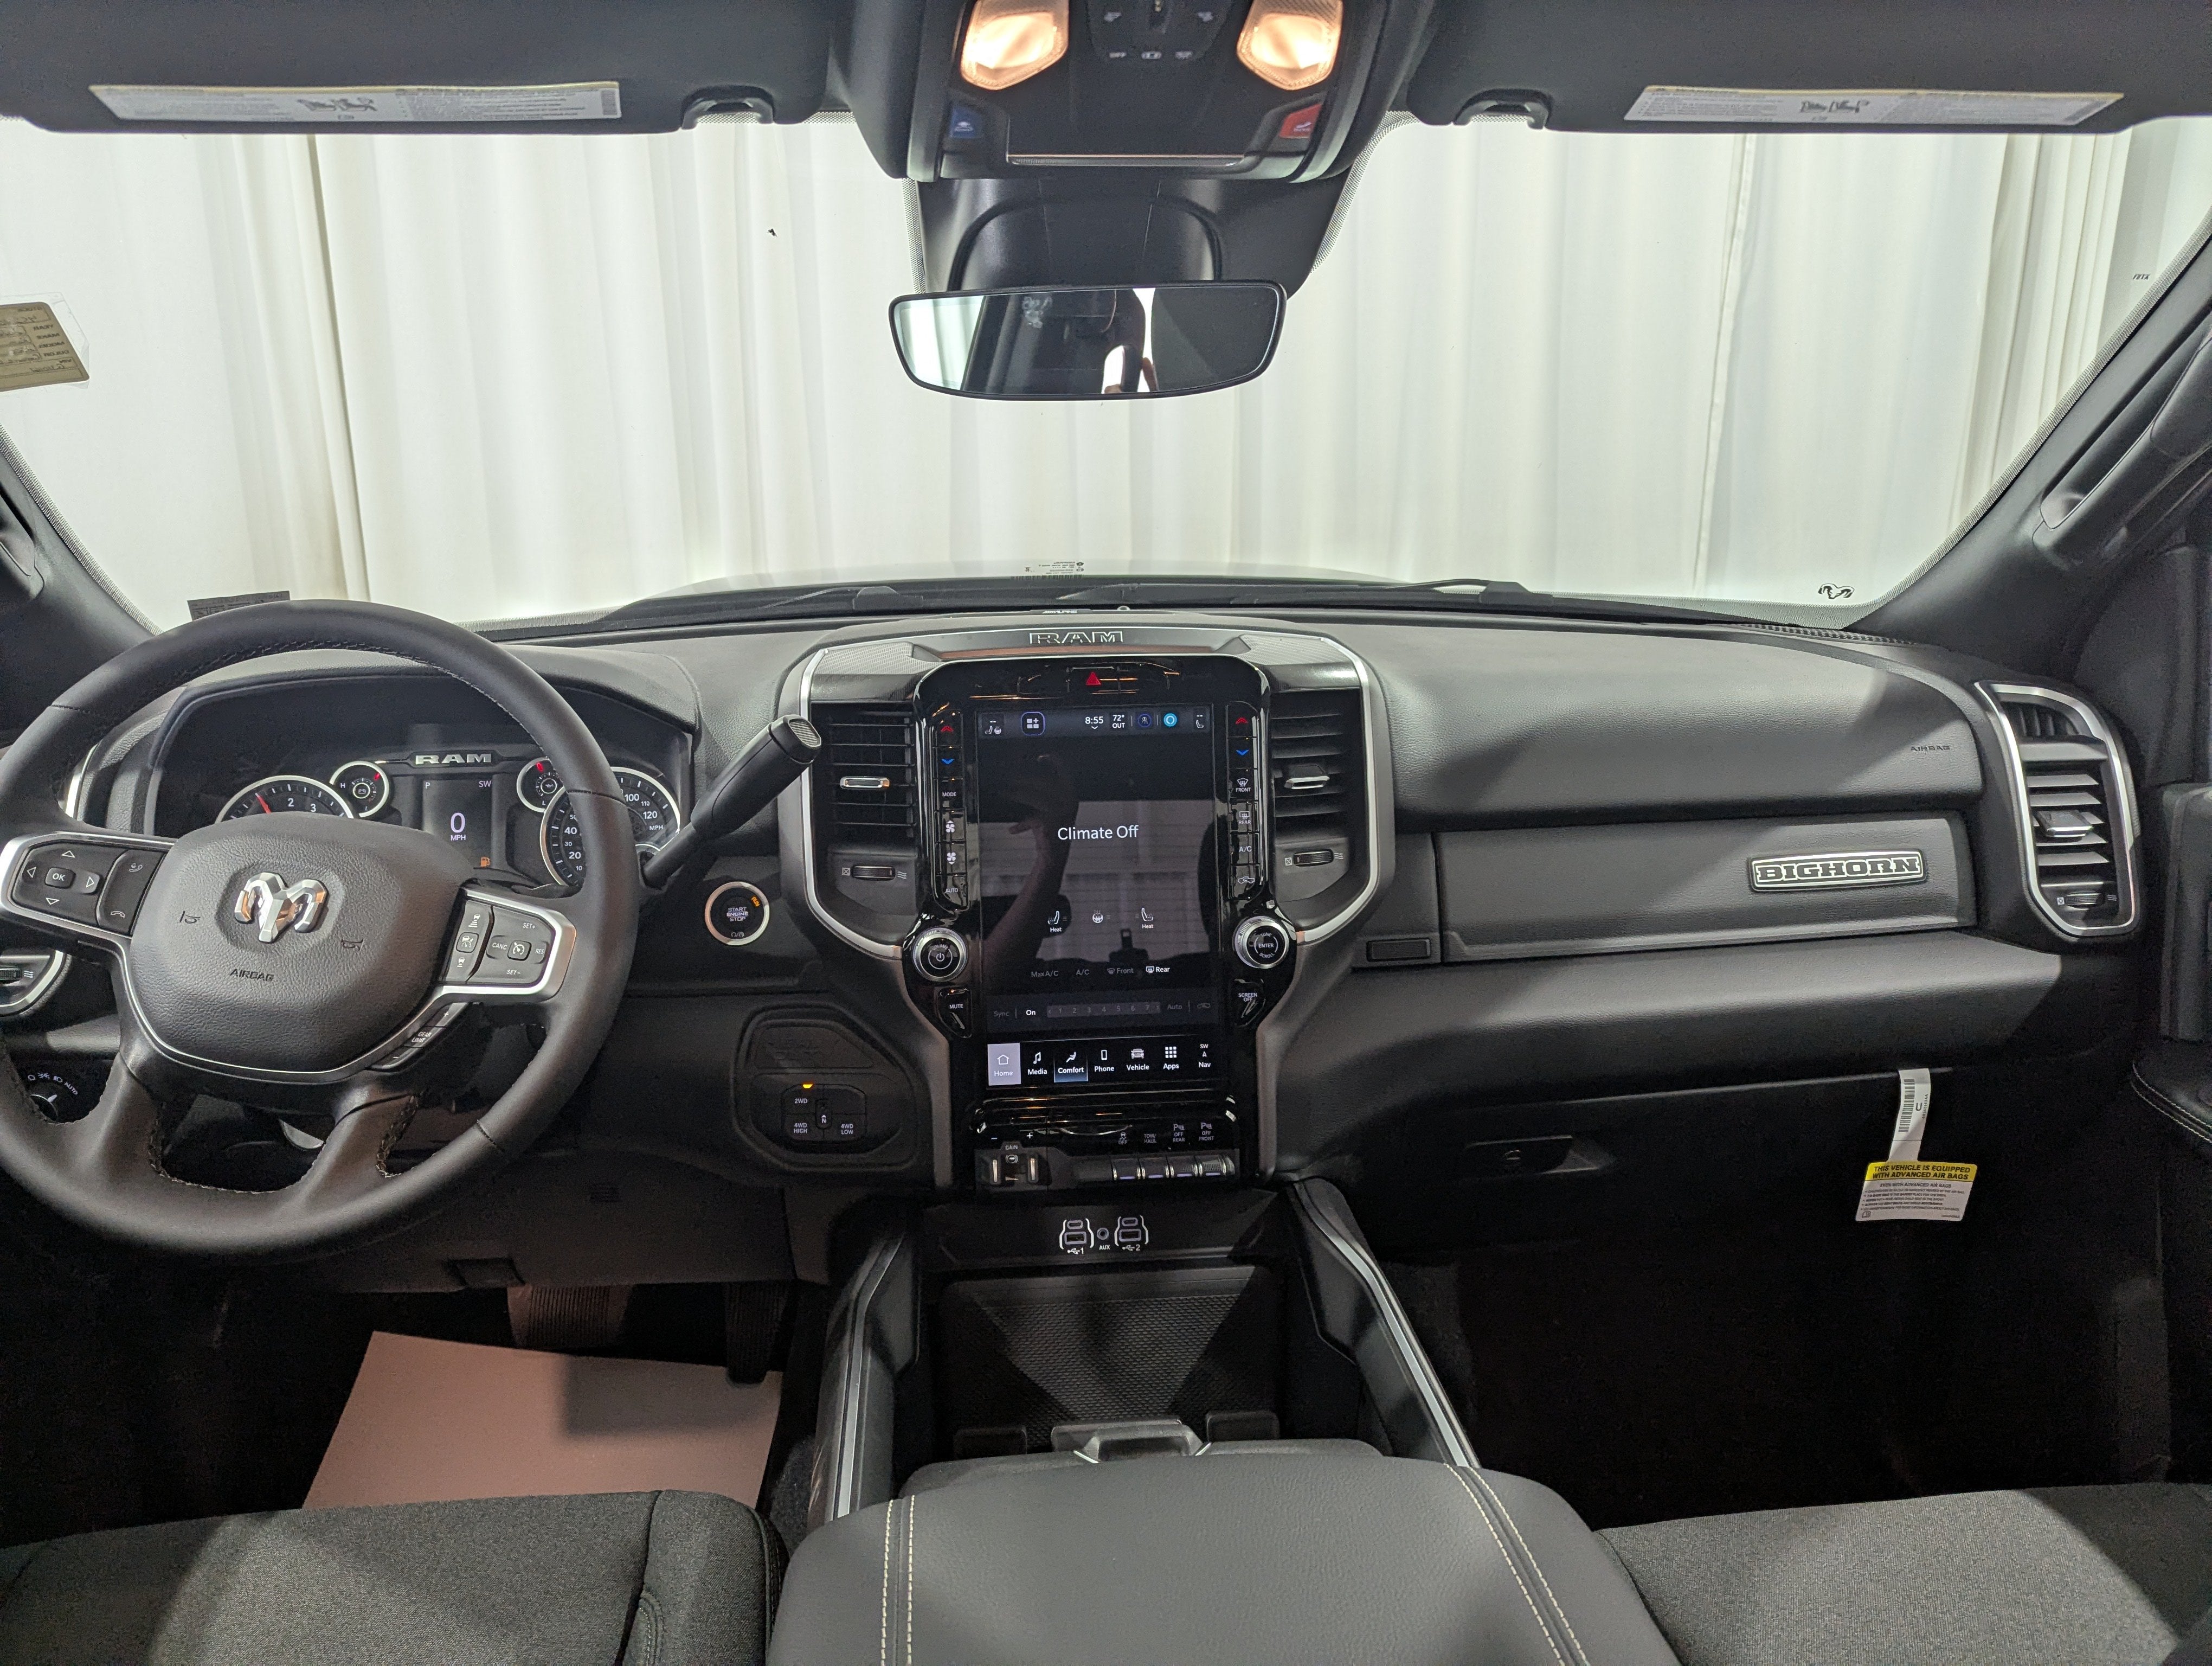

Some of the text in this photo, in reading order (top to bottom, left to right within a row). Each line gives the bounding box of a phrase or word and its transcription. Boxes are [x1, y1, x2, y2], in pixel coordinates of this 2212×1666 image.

[1030, 631, 1123, 644] RAM
[415, 754, 492, 765] RAM
[287, 798, 294, 807] 2
[624, 793, 640, 802] 100
[310, 803, 317, 812] 3
[642, 811, 658, 819] 120
[450, 812, 466, 834] 0
[1058, 825, 1139, 840] Climate Off
[1755, 856, 1921, 883] BIGHORN
[53, 873, 66, 881] OK
[229, 968, 274, 981] AIRBAG
[64, 1082, 78, 1095] AUTO
